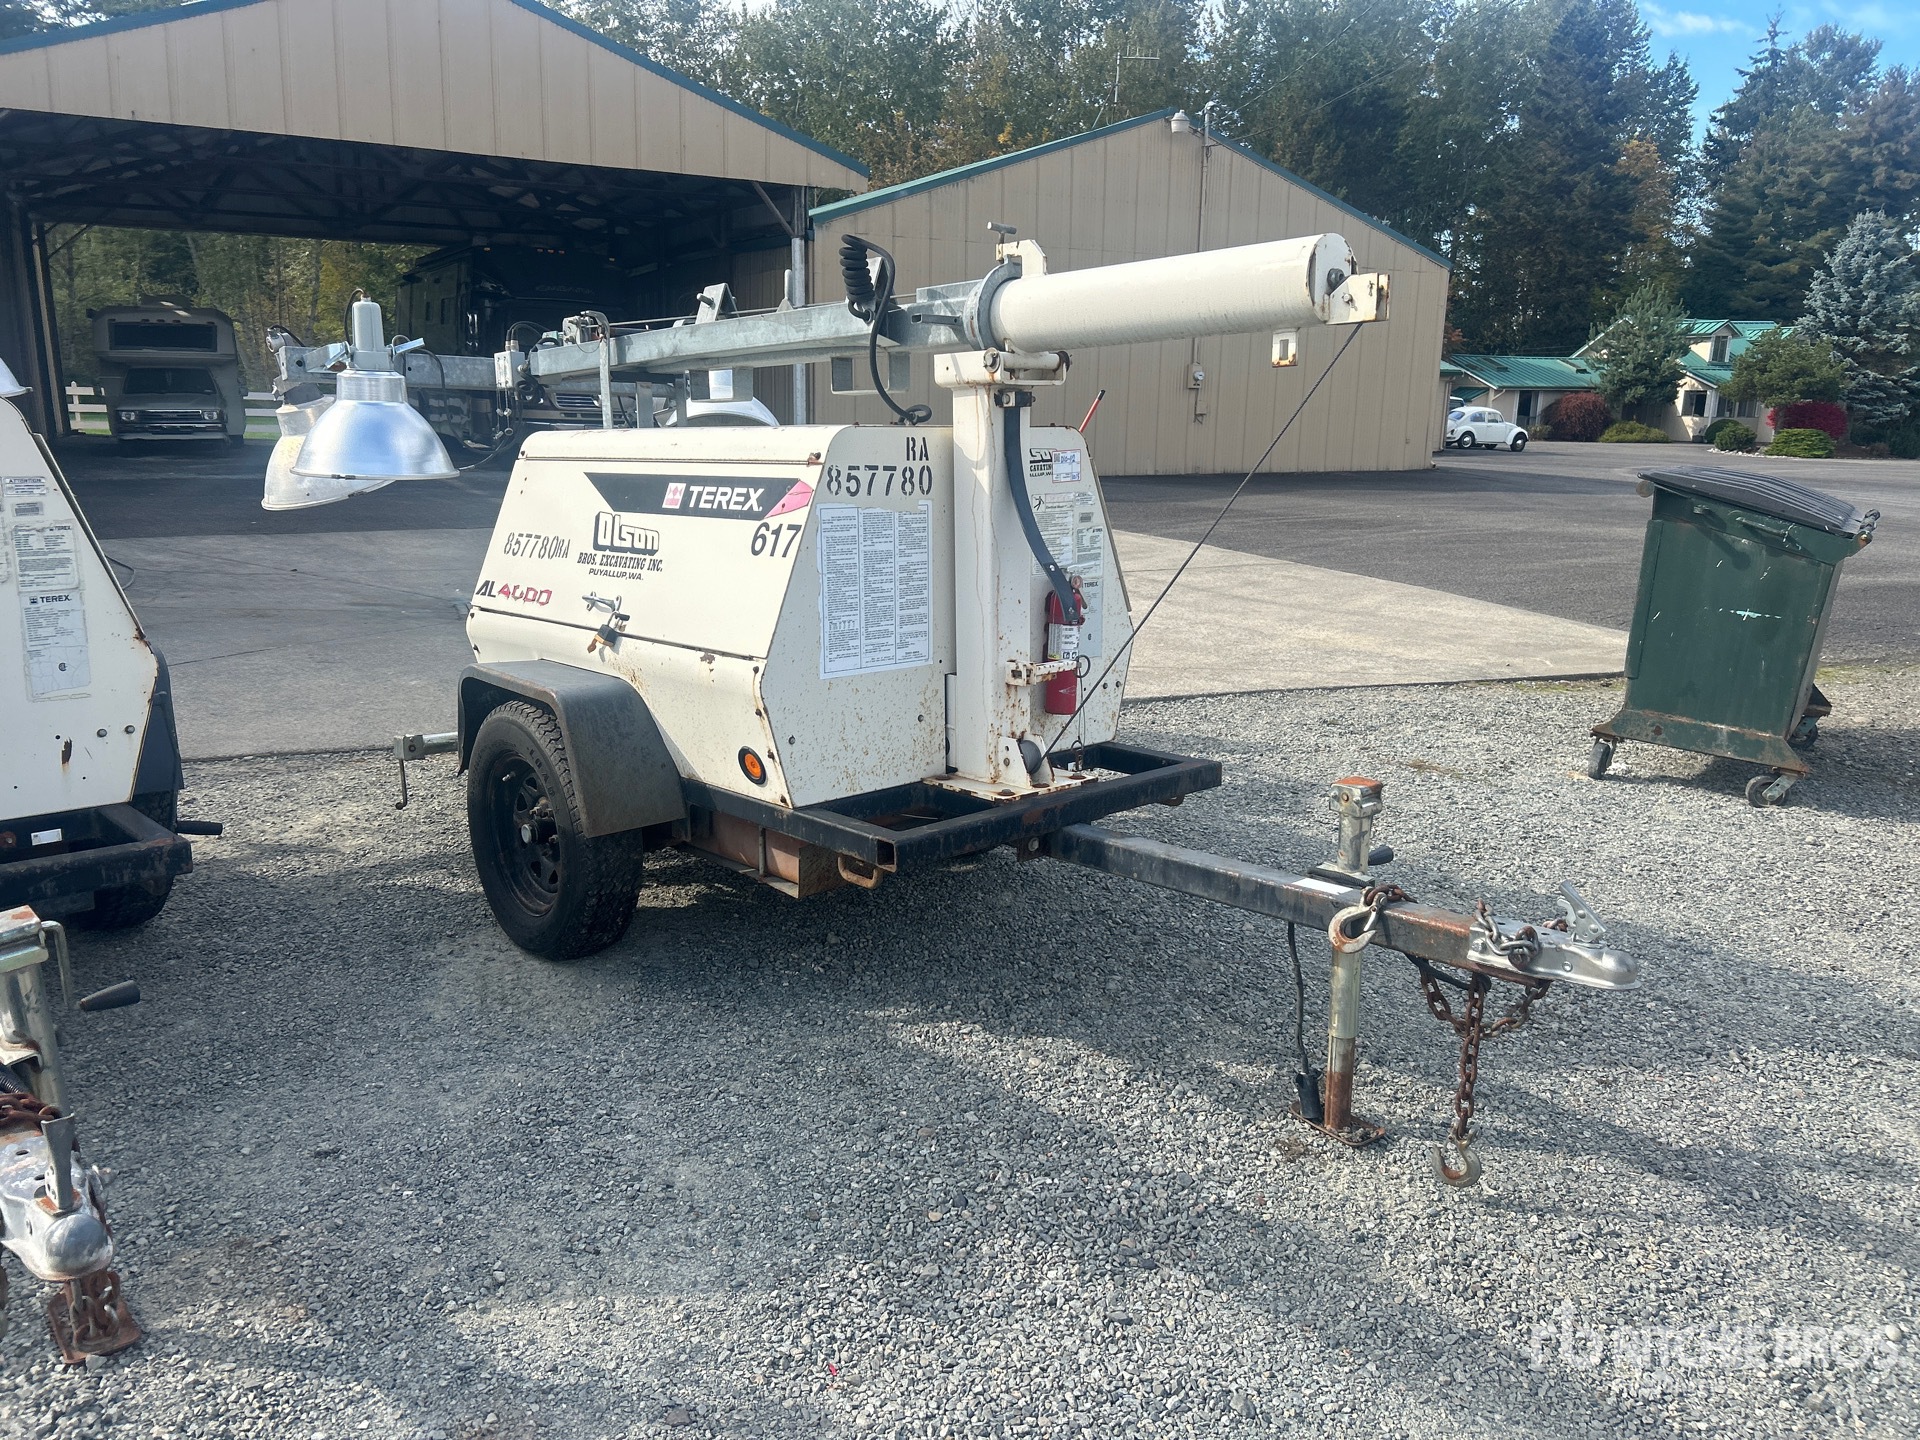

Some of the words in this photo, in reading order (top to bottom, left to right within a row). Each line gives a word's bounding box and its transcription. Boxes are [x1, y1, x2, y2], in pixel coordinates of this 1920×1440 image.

[906, 436, 929, 461] RA
[826, 464, 933, 497] 857780
[751, 521, 802, 558] 617
[577, 552, 597, 566] BROS.
[599, 553, 647, 571] EXCAVATING
[646, 558, 663, 572] INC.
